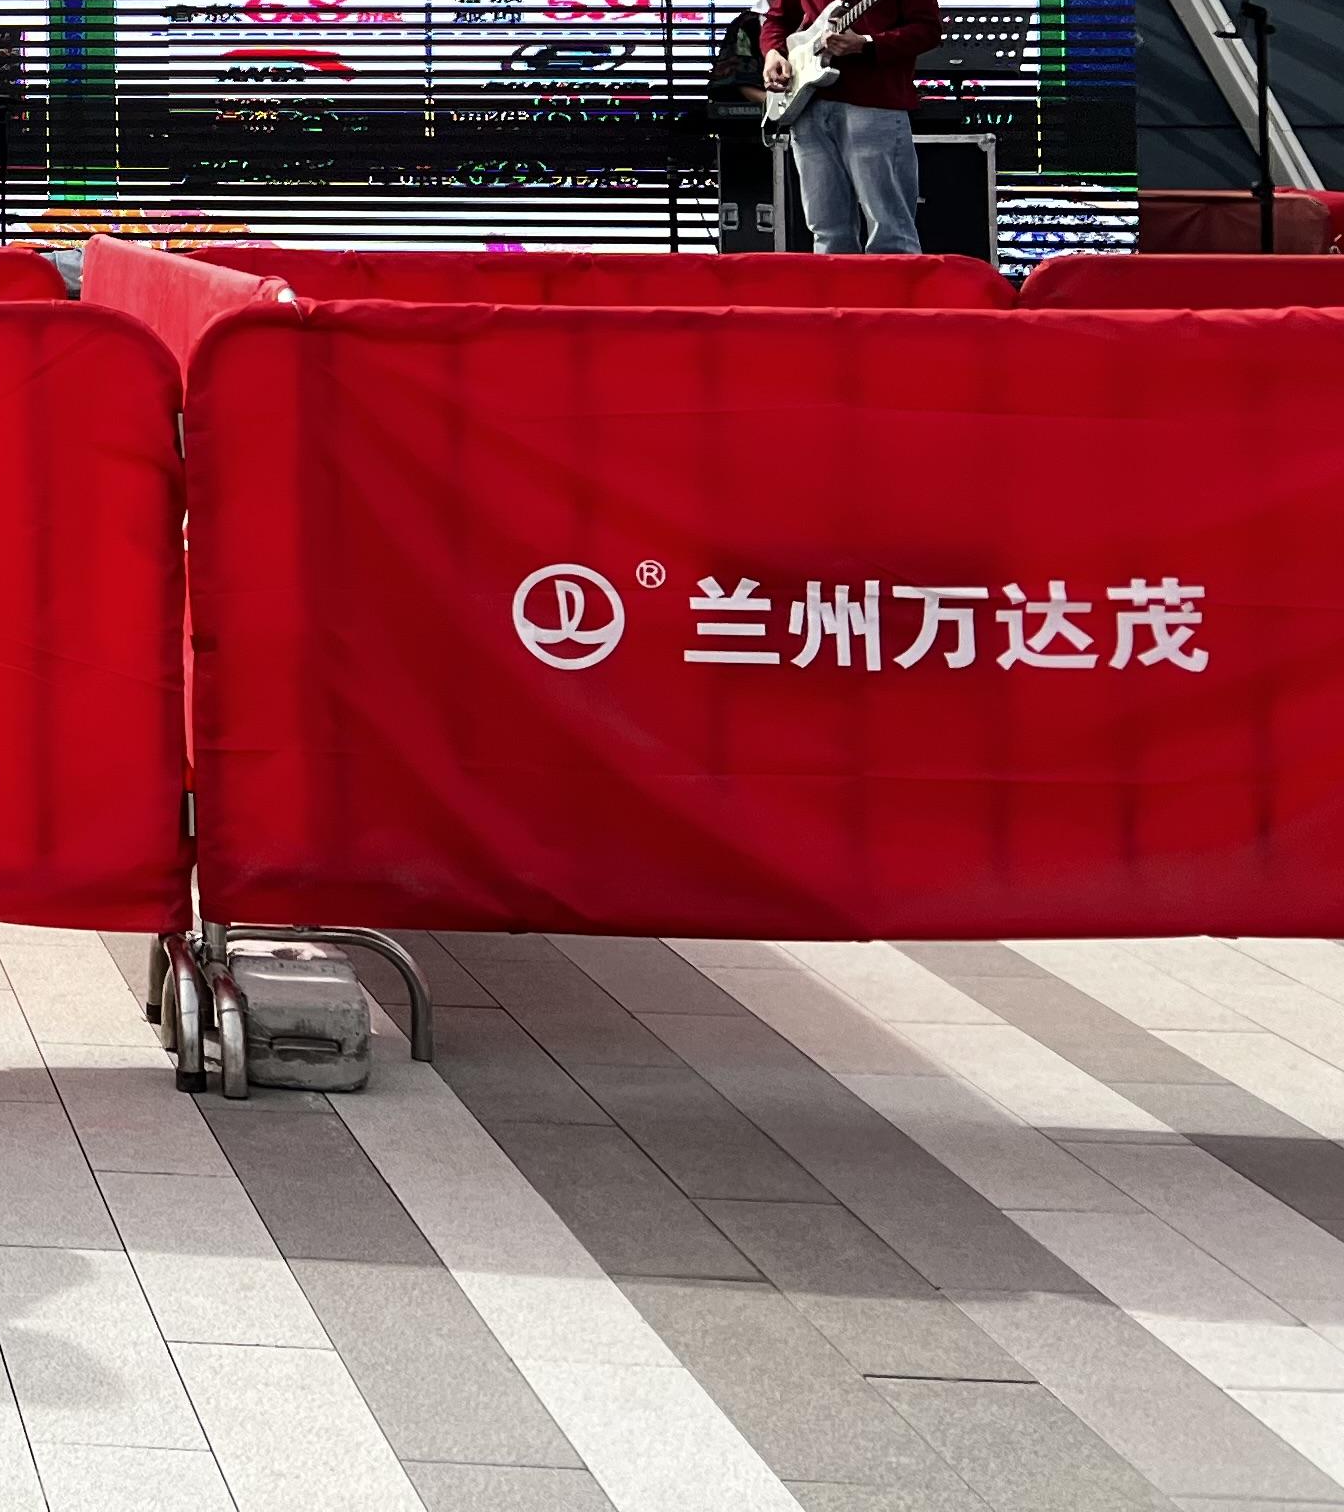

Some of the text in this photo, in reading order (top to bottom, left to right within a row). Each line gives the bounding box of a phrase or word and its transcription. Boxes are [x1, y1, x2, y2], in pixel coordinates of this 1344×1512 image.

[683, 575, 1210, 672] 兰州万达茂
